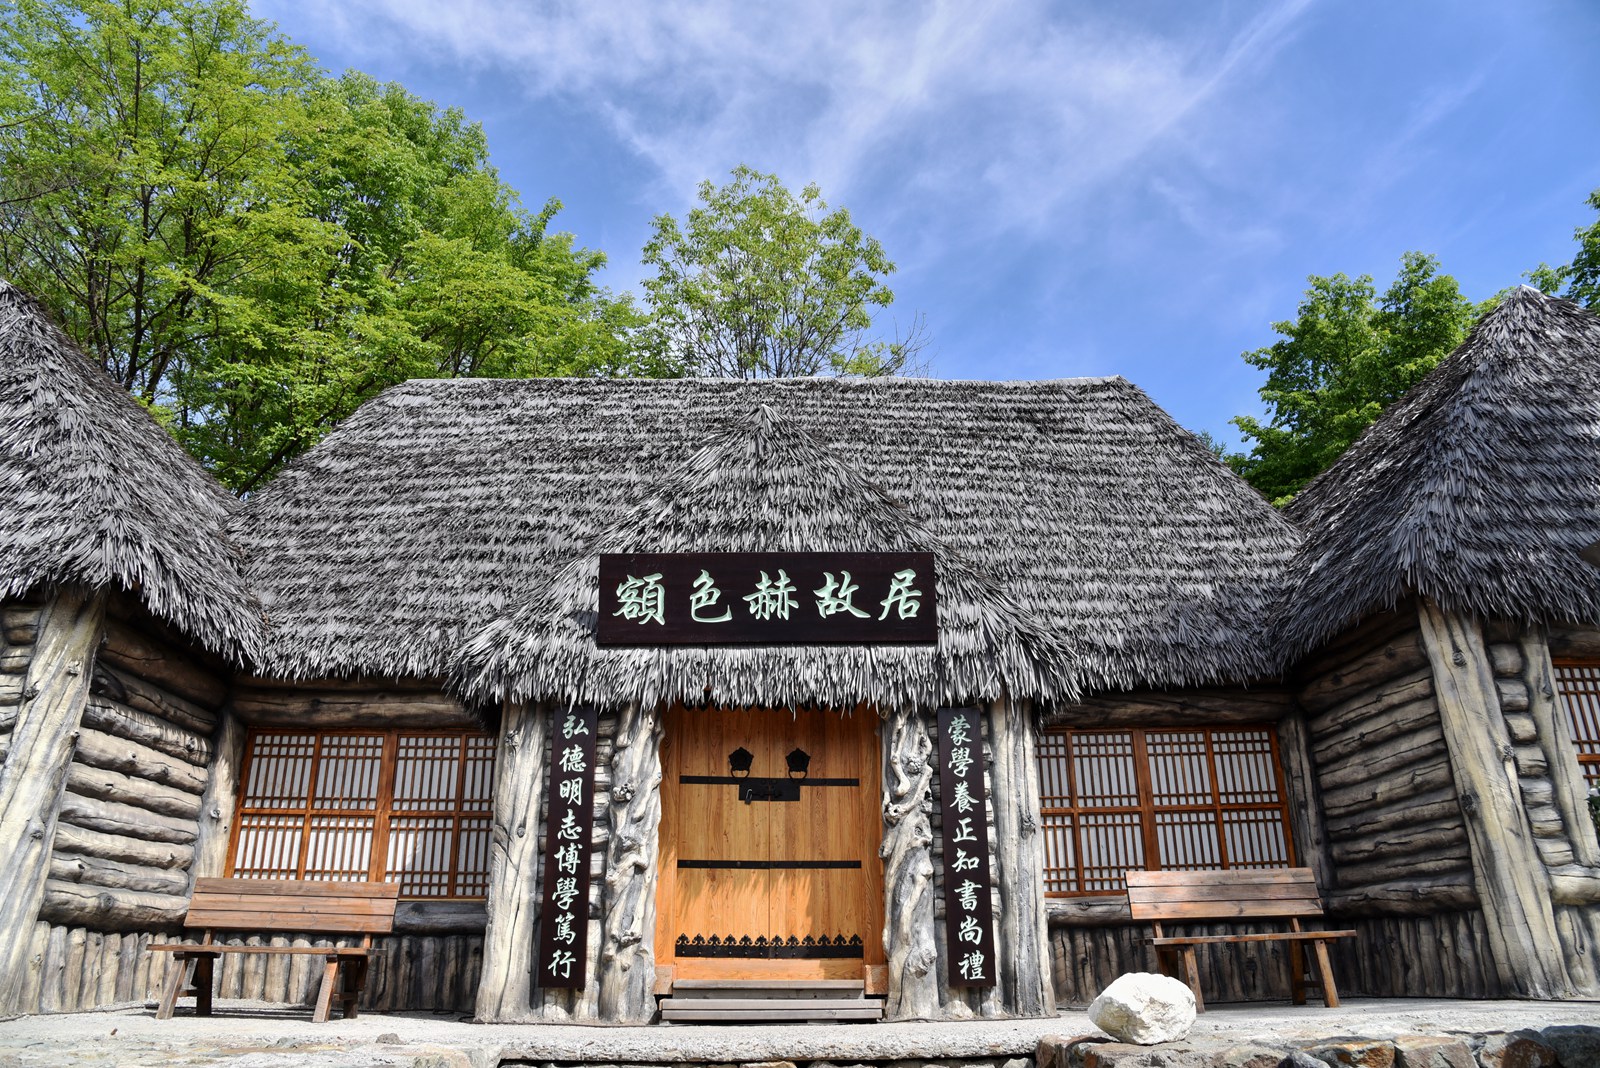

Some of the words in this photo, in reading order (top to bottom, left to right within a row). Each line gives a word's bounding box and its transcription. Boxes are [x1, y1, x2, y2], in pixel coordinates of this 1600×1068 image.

[612, 568, 923, 626] 額色赫故居
[547, 714, 589, 980] 弘德明志博學篤行
[947, 713, 986, 981] 蒙學養正知書尚禮
